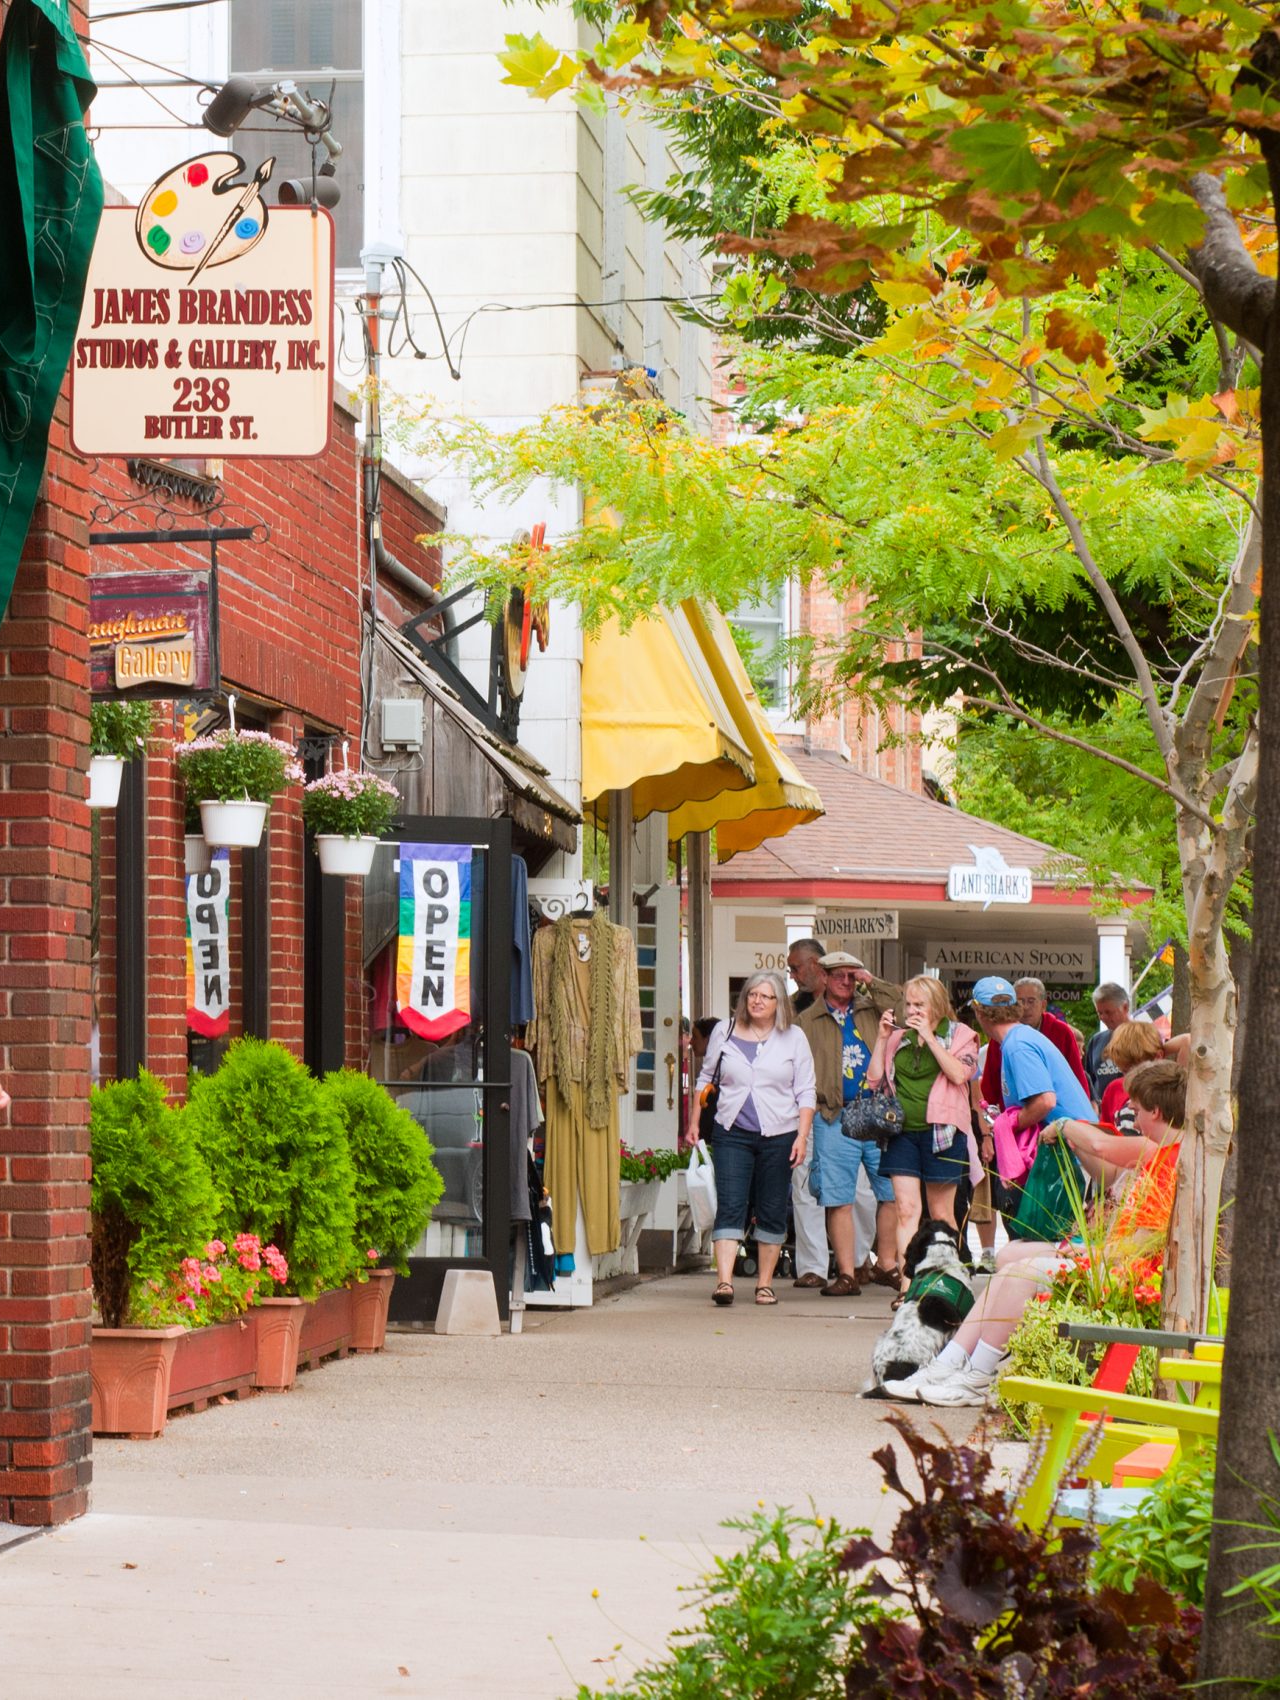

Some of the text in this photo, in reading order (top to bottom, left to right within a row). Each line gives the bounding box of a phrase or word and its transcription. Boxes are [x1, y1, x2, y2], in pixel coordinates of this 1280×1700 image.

[91, 288, 313, 329] JAMES BRANDESS
[76, 338, 326, 374] STUDIOS & GALLERY, INC.
[172, 376, 231, 412] 238
[144, 415, 258, 439] BUTLER ST.
[119, 647, 192, 682] Gallery
[953, 873, 981, 896] LAND
[421, 867, 450, 1008] OPEN
[813, 917, 885, 935] ANDSHARK'S
[754, 952, 787, 971] 306
[934, 947, 1084, 966] AMERICAN SPOON
